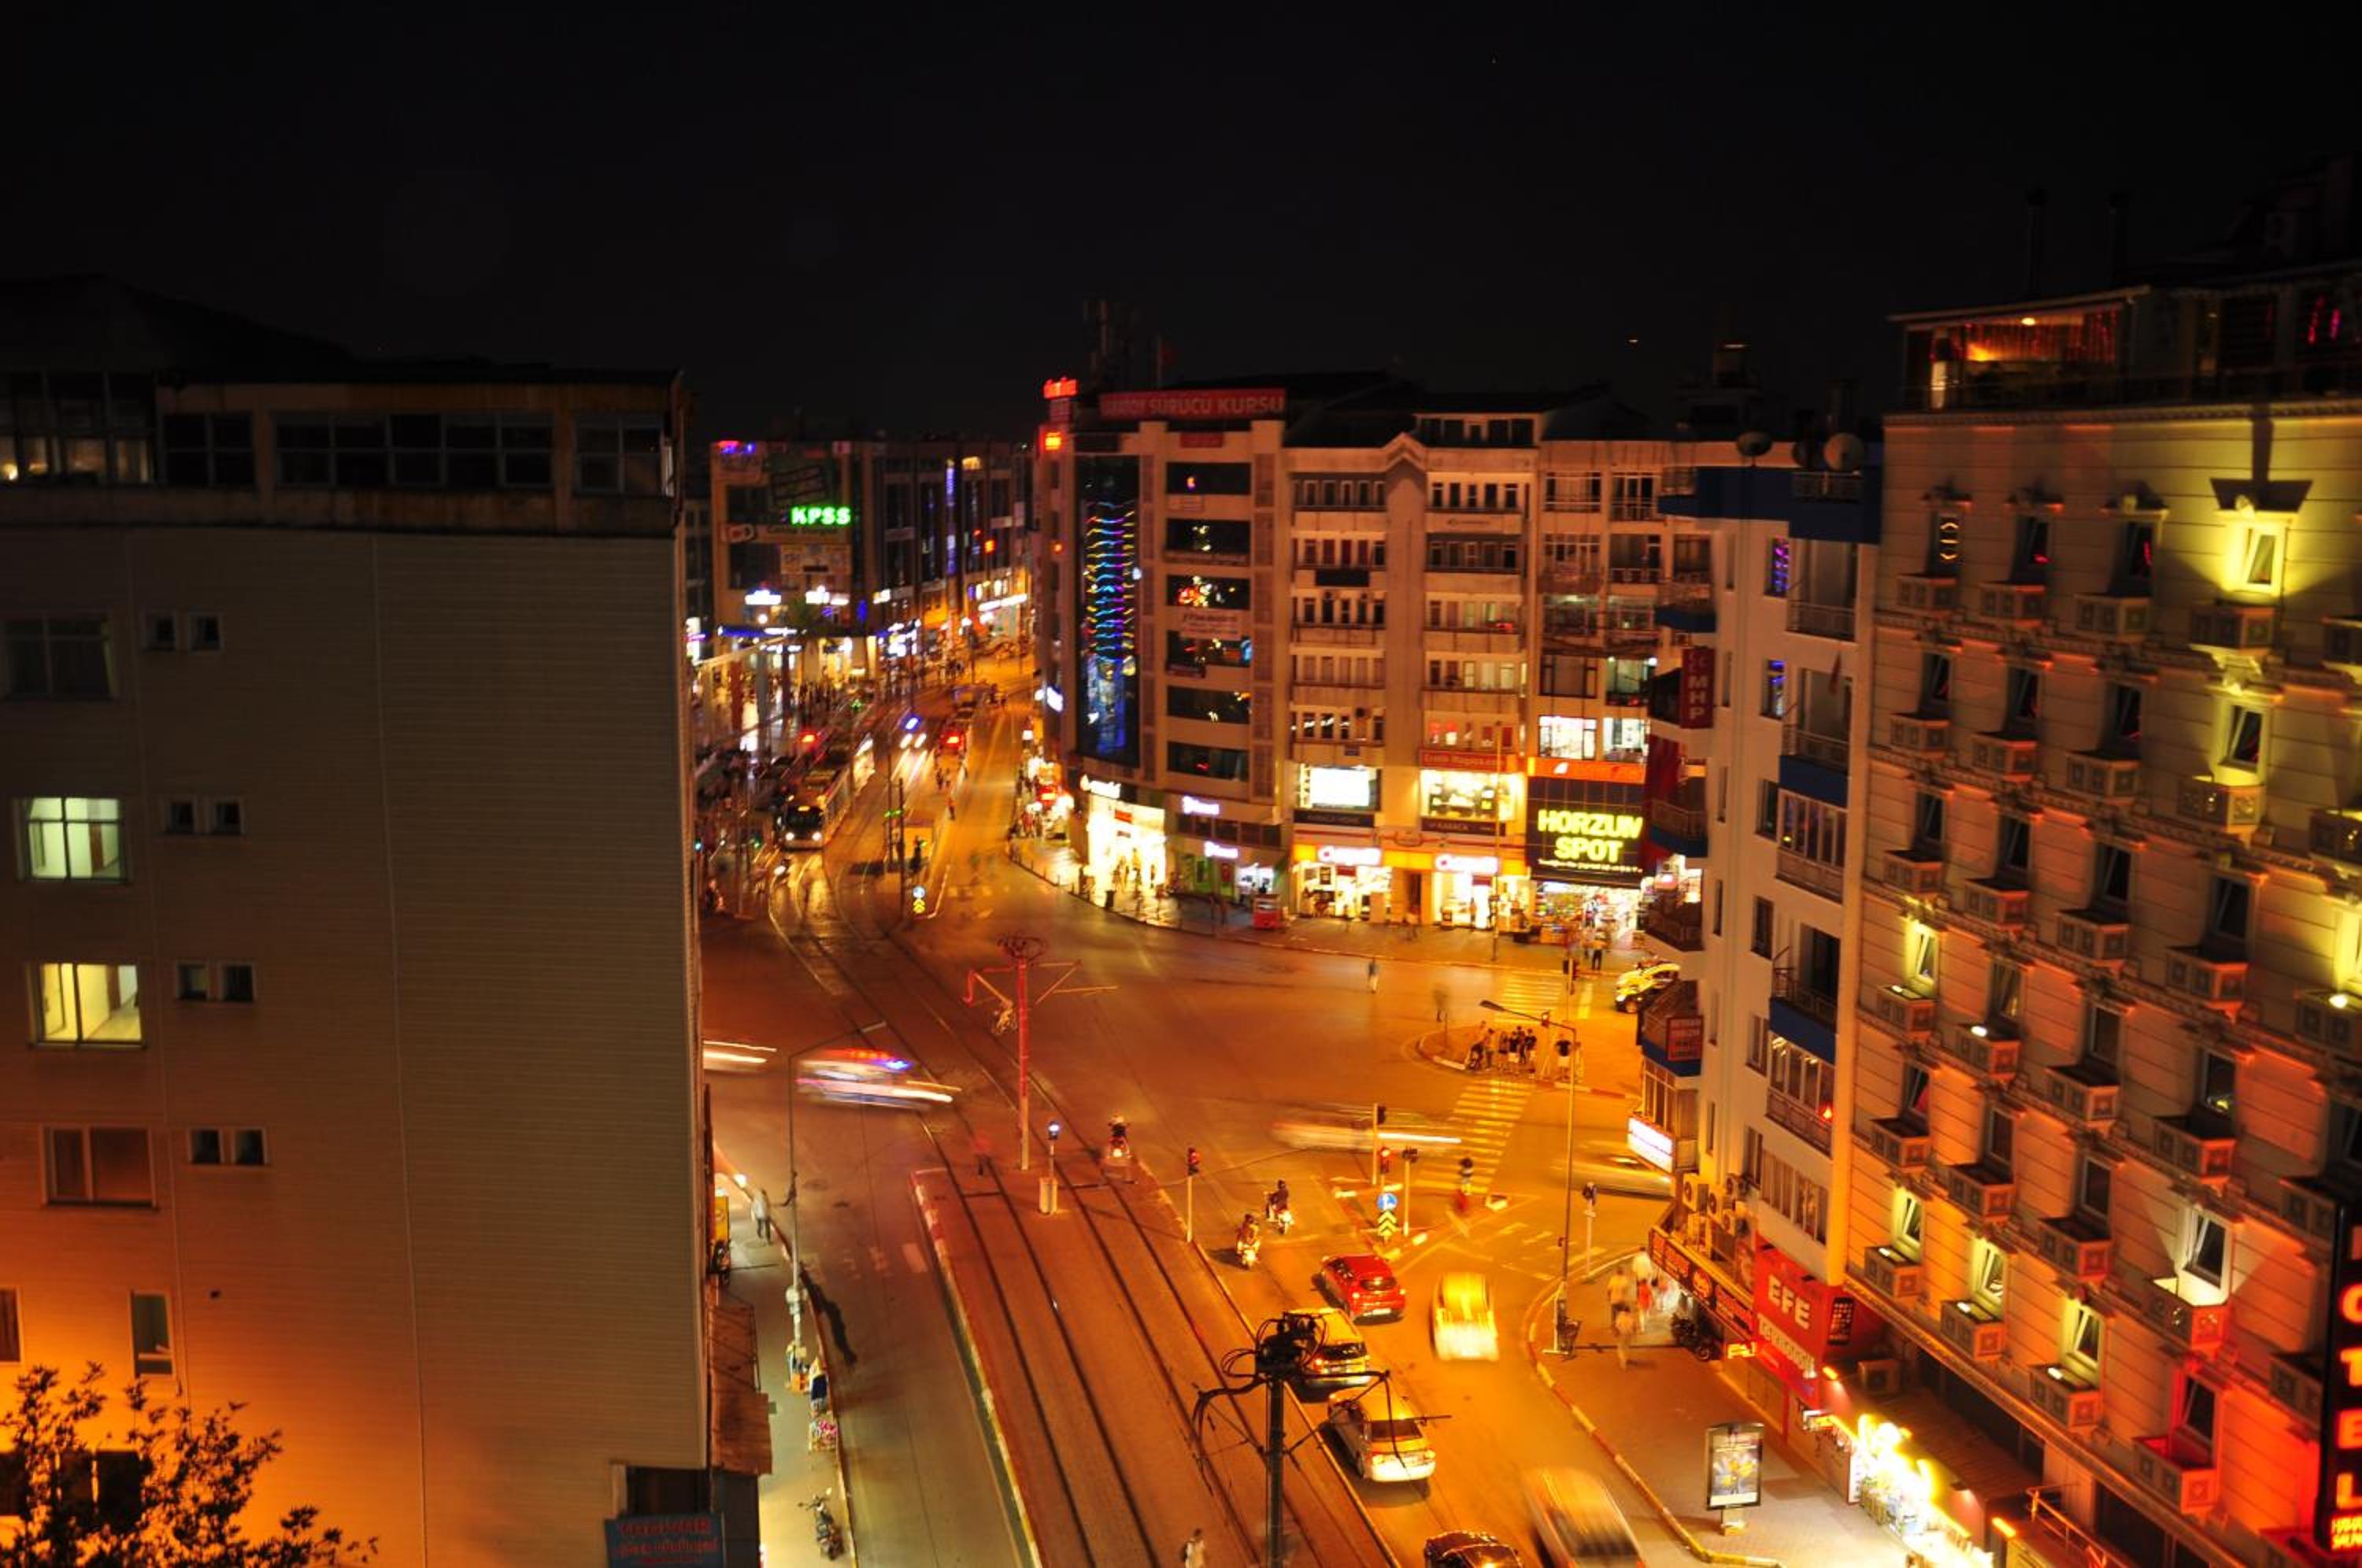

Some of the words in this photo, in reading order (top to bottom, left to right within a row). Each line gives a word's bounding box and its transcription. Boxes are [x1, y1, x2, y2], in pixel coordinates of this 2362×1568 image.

[1218, 396, 1285, 414] KURSU
[791, 506, 851, 525] KPSS
[1688, 675, 1708, 719] MHP
[1538, 809, 1643, 838] HORZUM
[1554, 836, 1623, 863] SPOT
[1768, 1274, 1810, 1329] EFE
